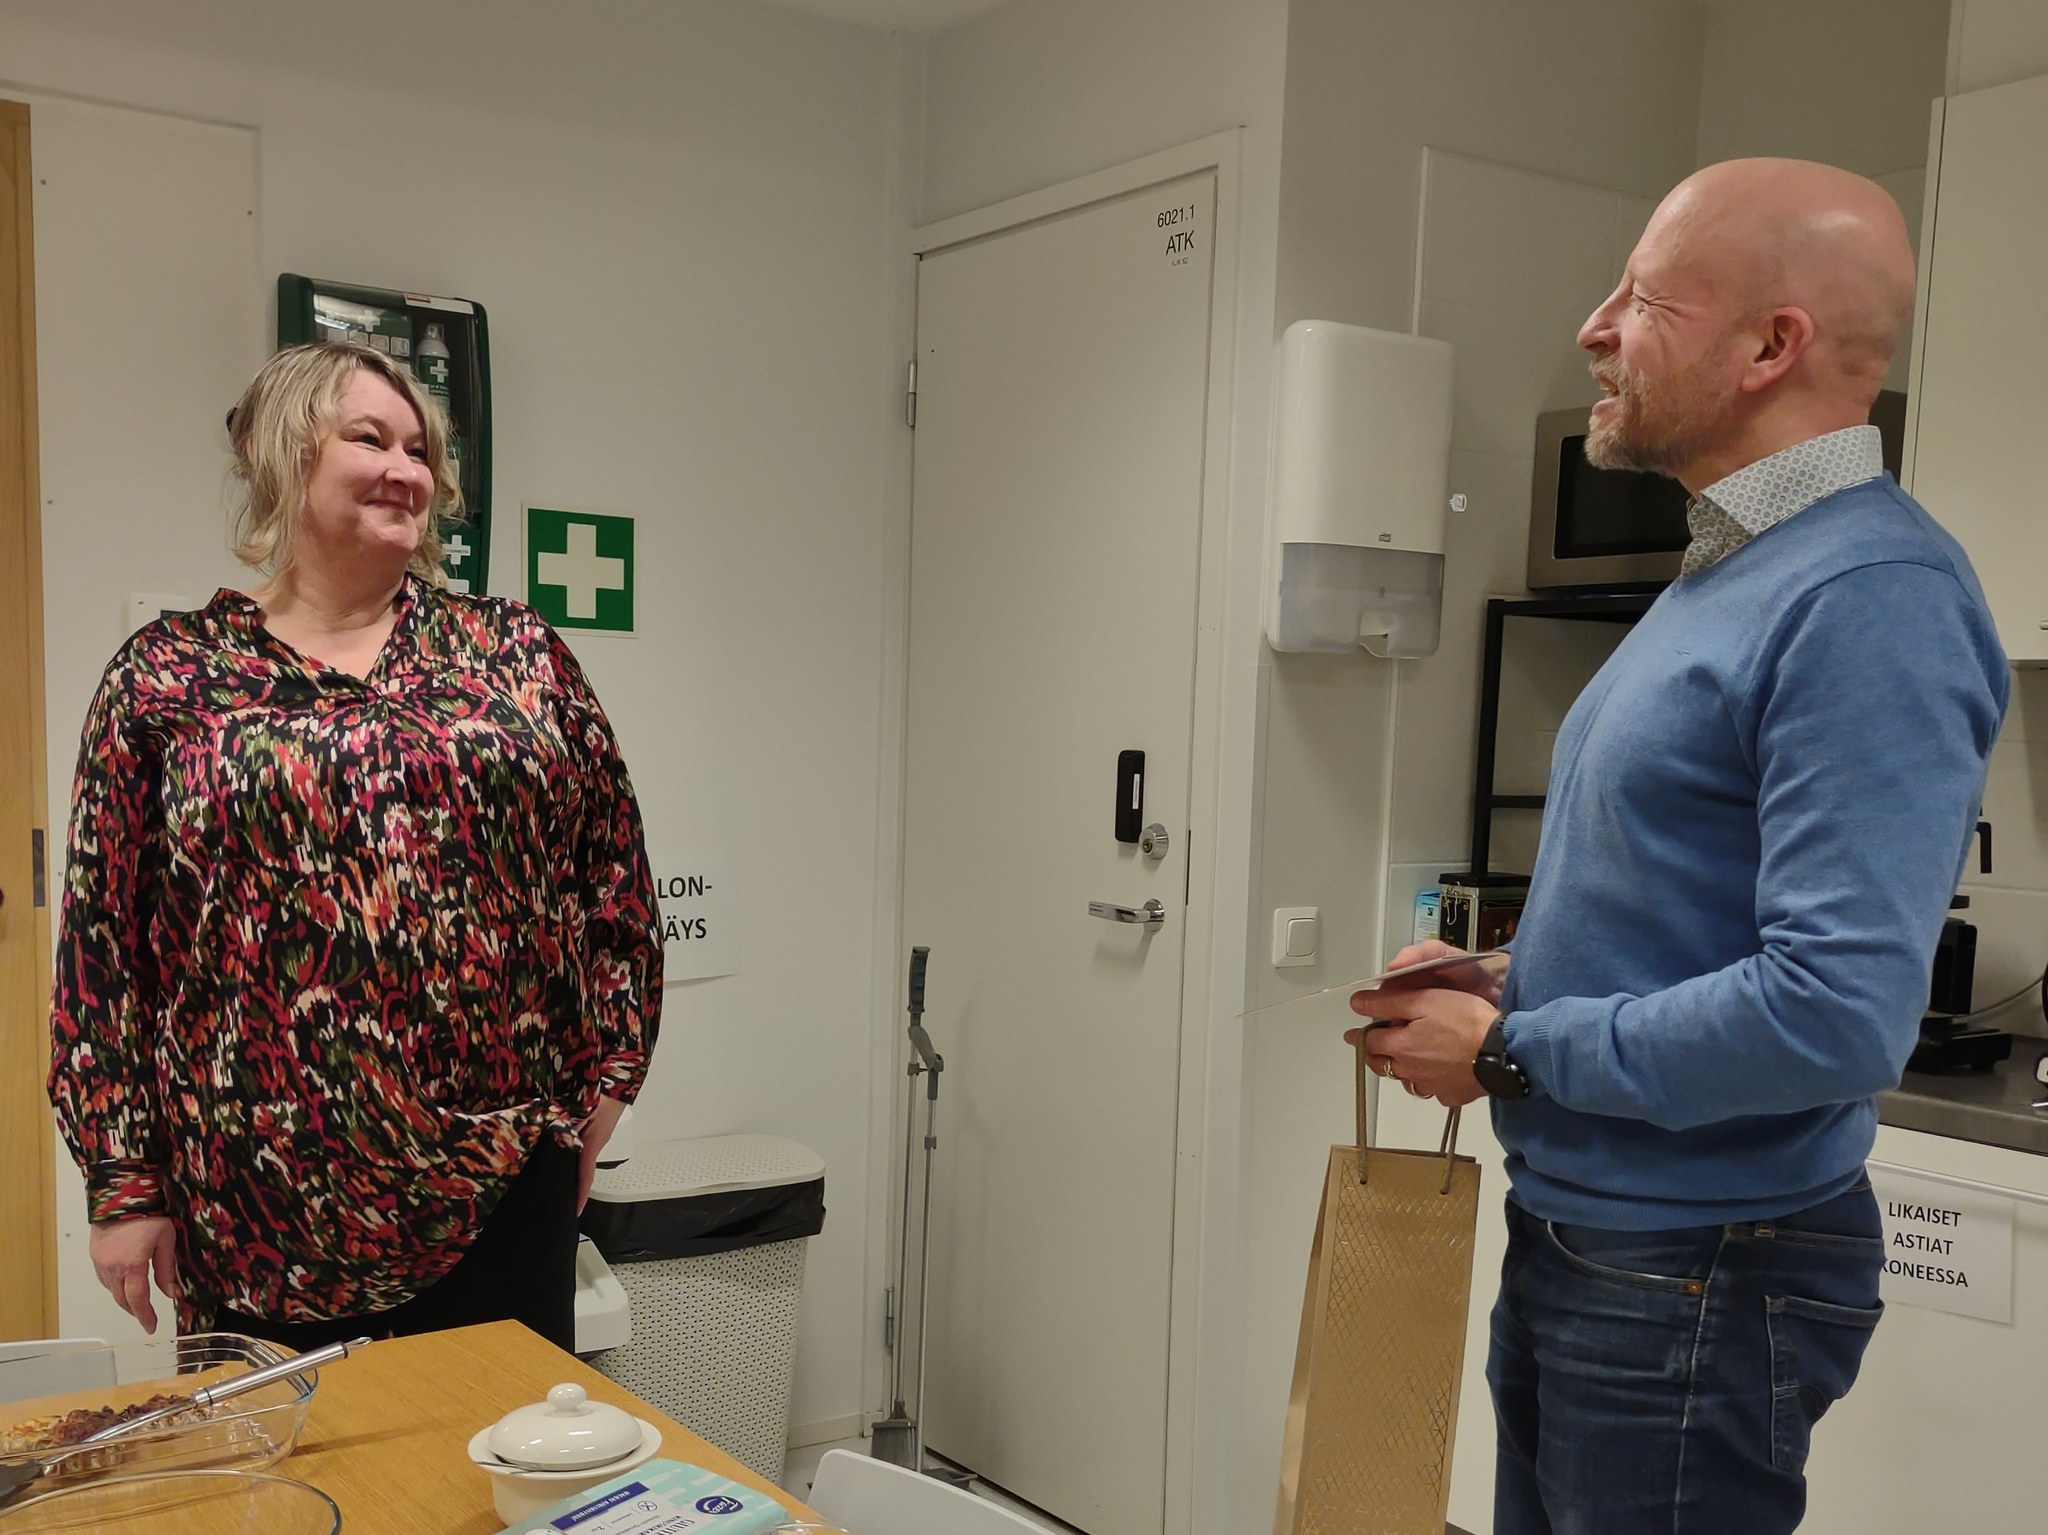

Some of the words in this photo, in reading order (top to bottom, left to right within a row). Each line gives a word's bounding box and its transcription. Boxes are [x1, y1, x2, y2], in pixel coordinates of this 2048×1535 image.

[1157, 204, 1194, 228] 6021.1
[1165, 230, 1195, 256] ATK
[657, 875, 712, 899] LON-
[664, 915, 707, 942] ÄYS
[1888, 1202, 1962, 1227] LIKAISET
[1893, 1232, 1953, 1255] ASTIAT
